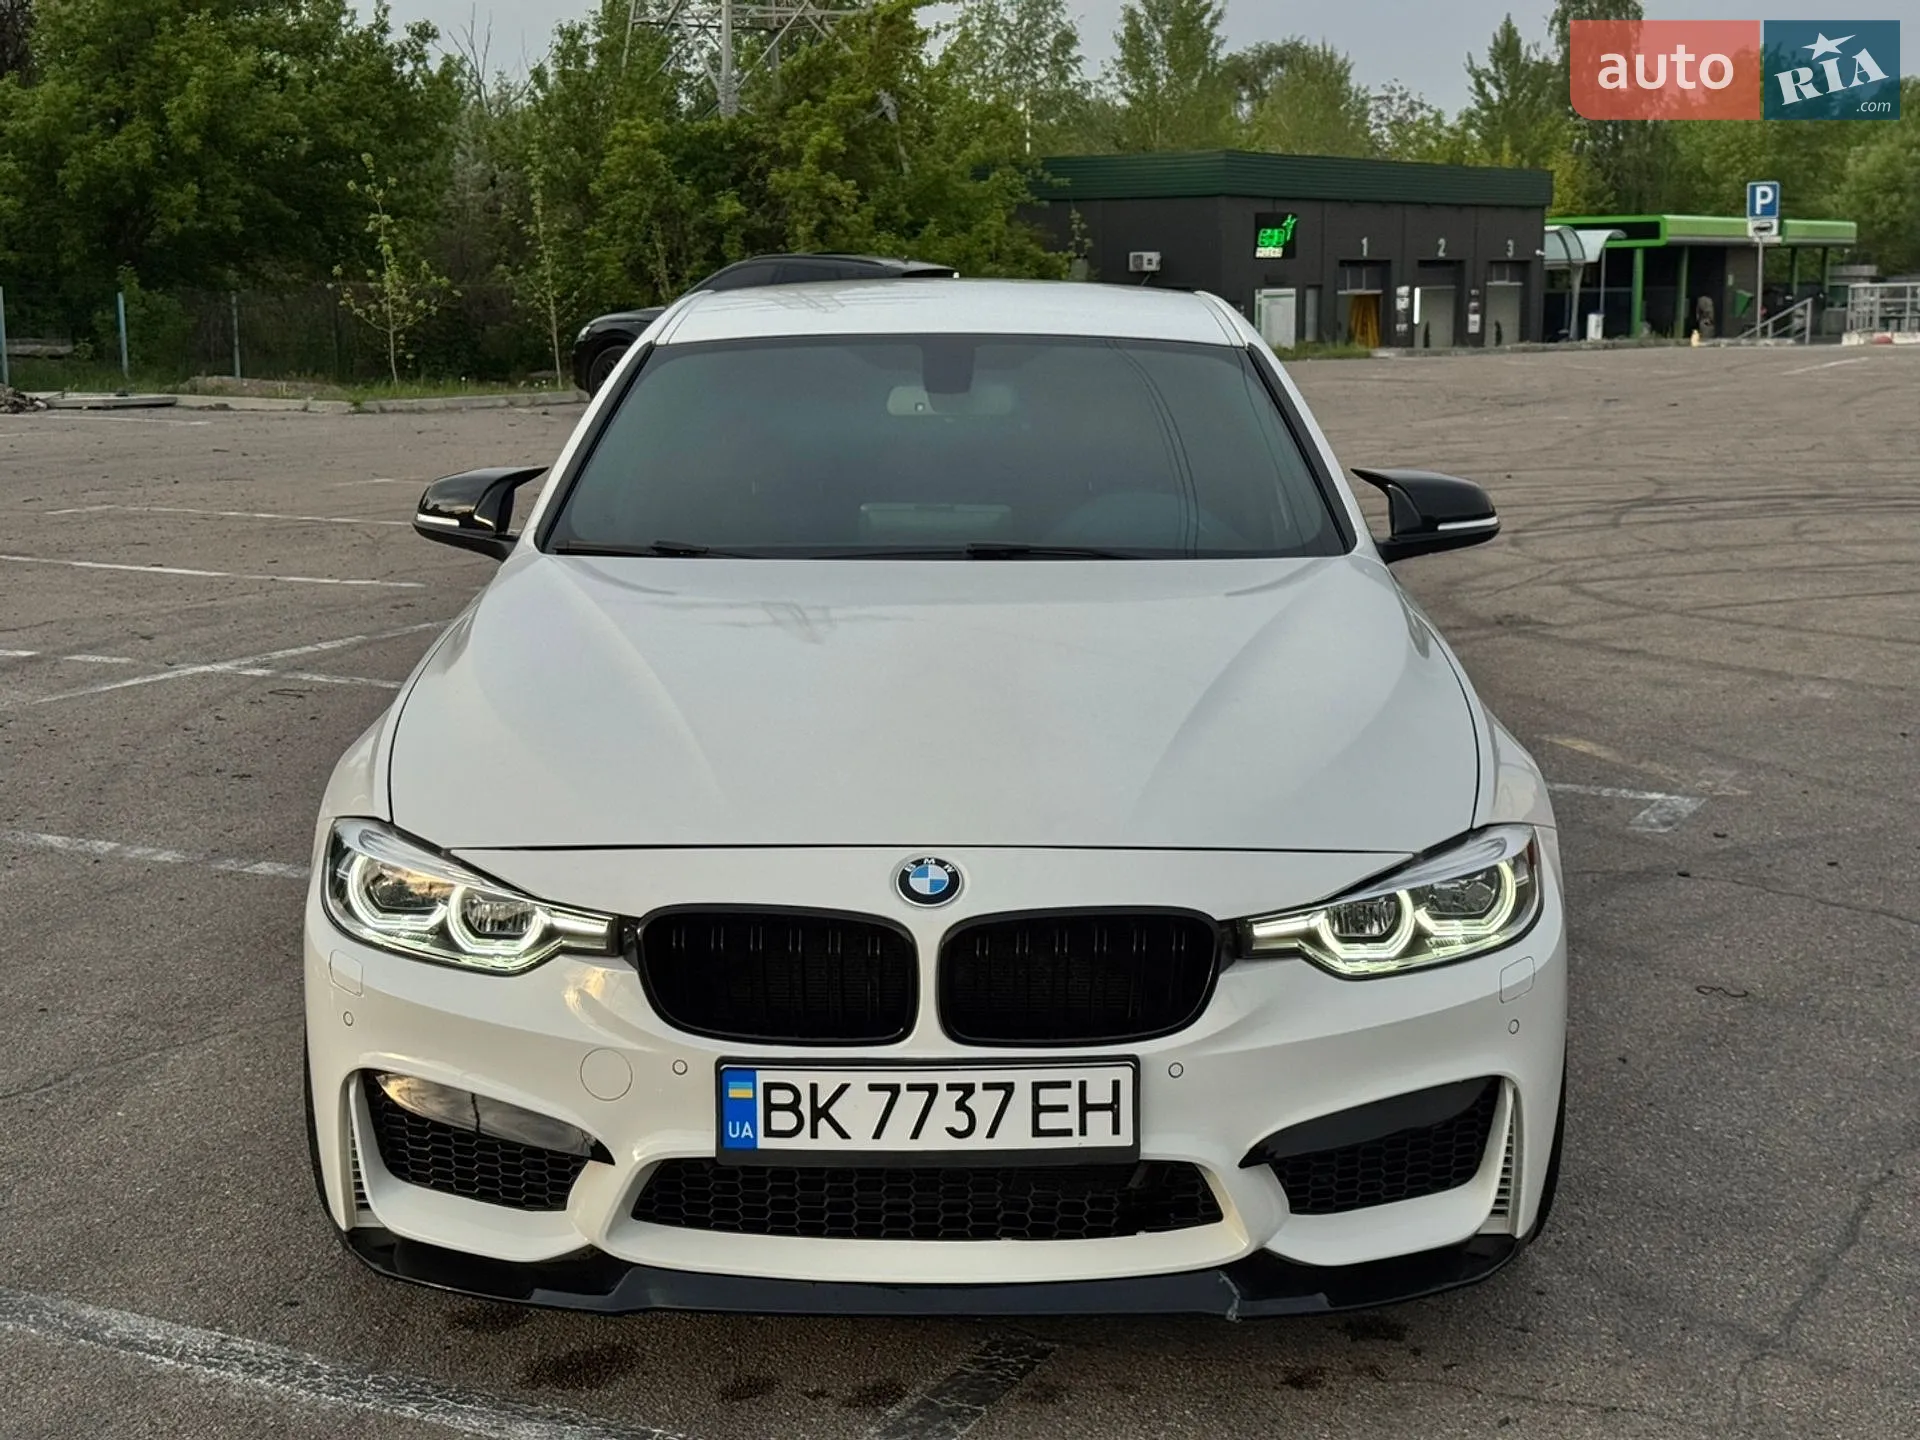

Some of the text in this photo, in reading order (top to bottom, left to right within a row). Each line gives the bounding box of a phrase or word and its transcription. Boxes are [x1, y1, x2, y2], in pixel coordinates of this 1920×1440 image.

[1755, 185, 1774, 215] P
[1361, 236, 1369, 257] 1
[1437, 237, 1446, 257] 2
[1507, 239, 1514, 258] 3
[904, 857, 955, 873] BMW
[762, 1079, 1121, 1140] BK 7737 EH
[727, 1120, 755, 1139] UA
